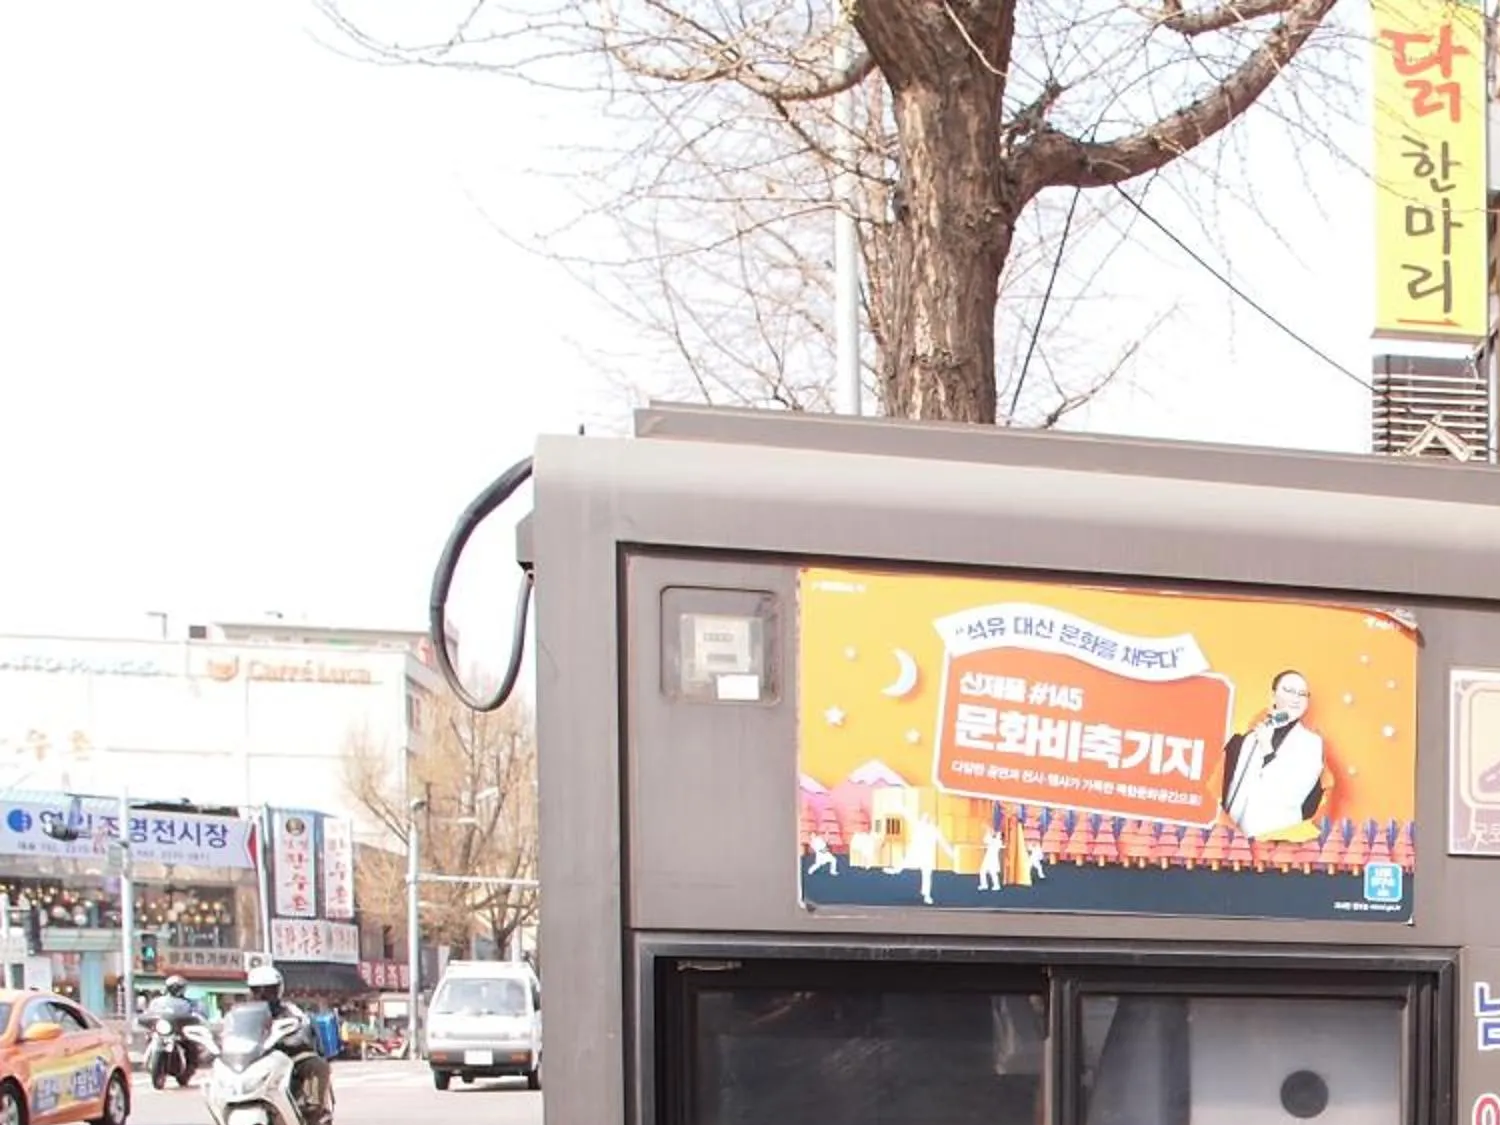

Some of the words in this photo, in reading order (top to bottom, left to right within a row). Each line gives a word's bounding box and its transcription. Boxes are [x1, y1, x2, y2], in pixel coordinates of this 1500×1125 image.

[1380, 22, 1469, 124] 닭
[1013, 615, 1055, 640] 대신
[1059, 623, 1120, 661] 문화를
[955, 702, 1206, 781] 문화비축기지
